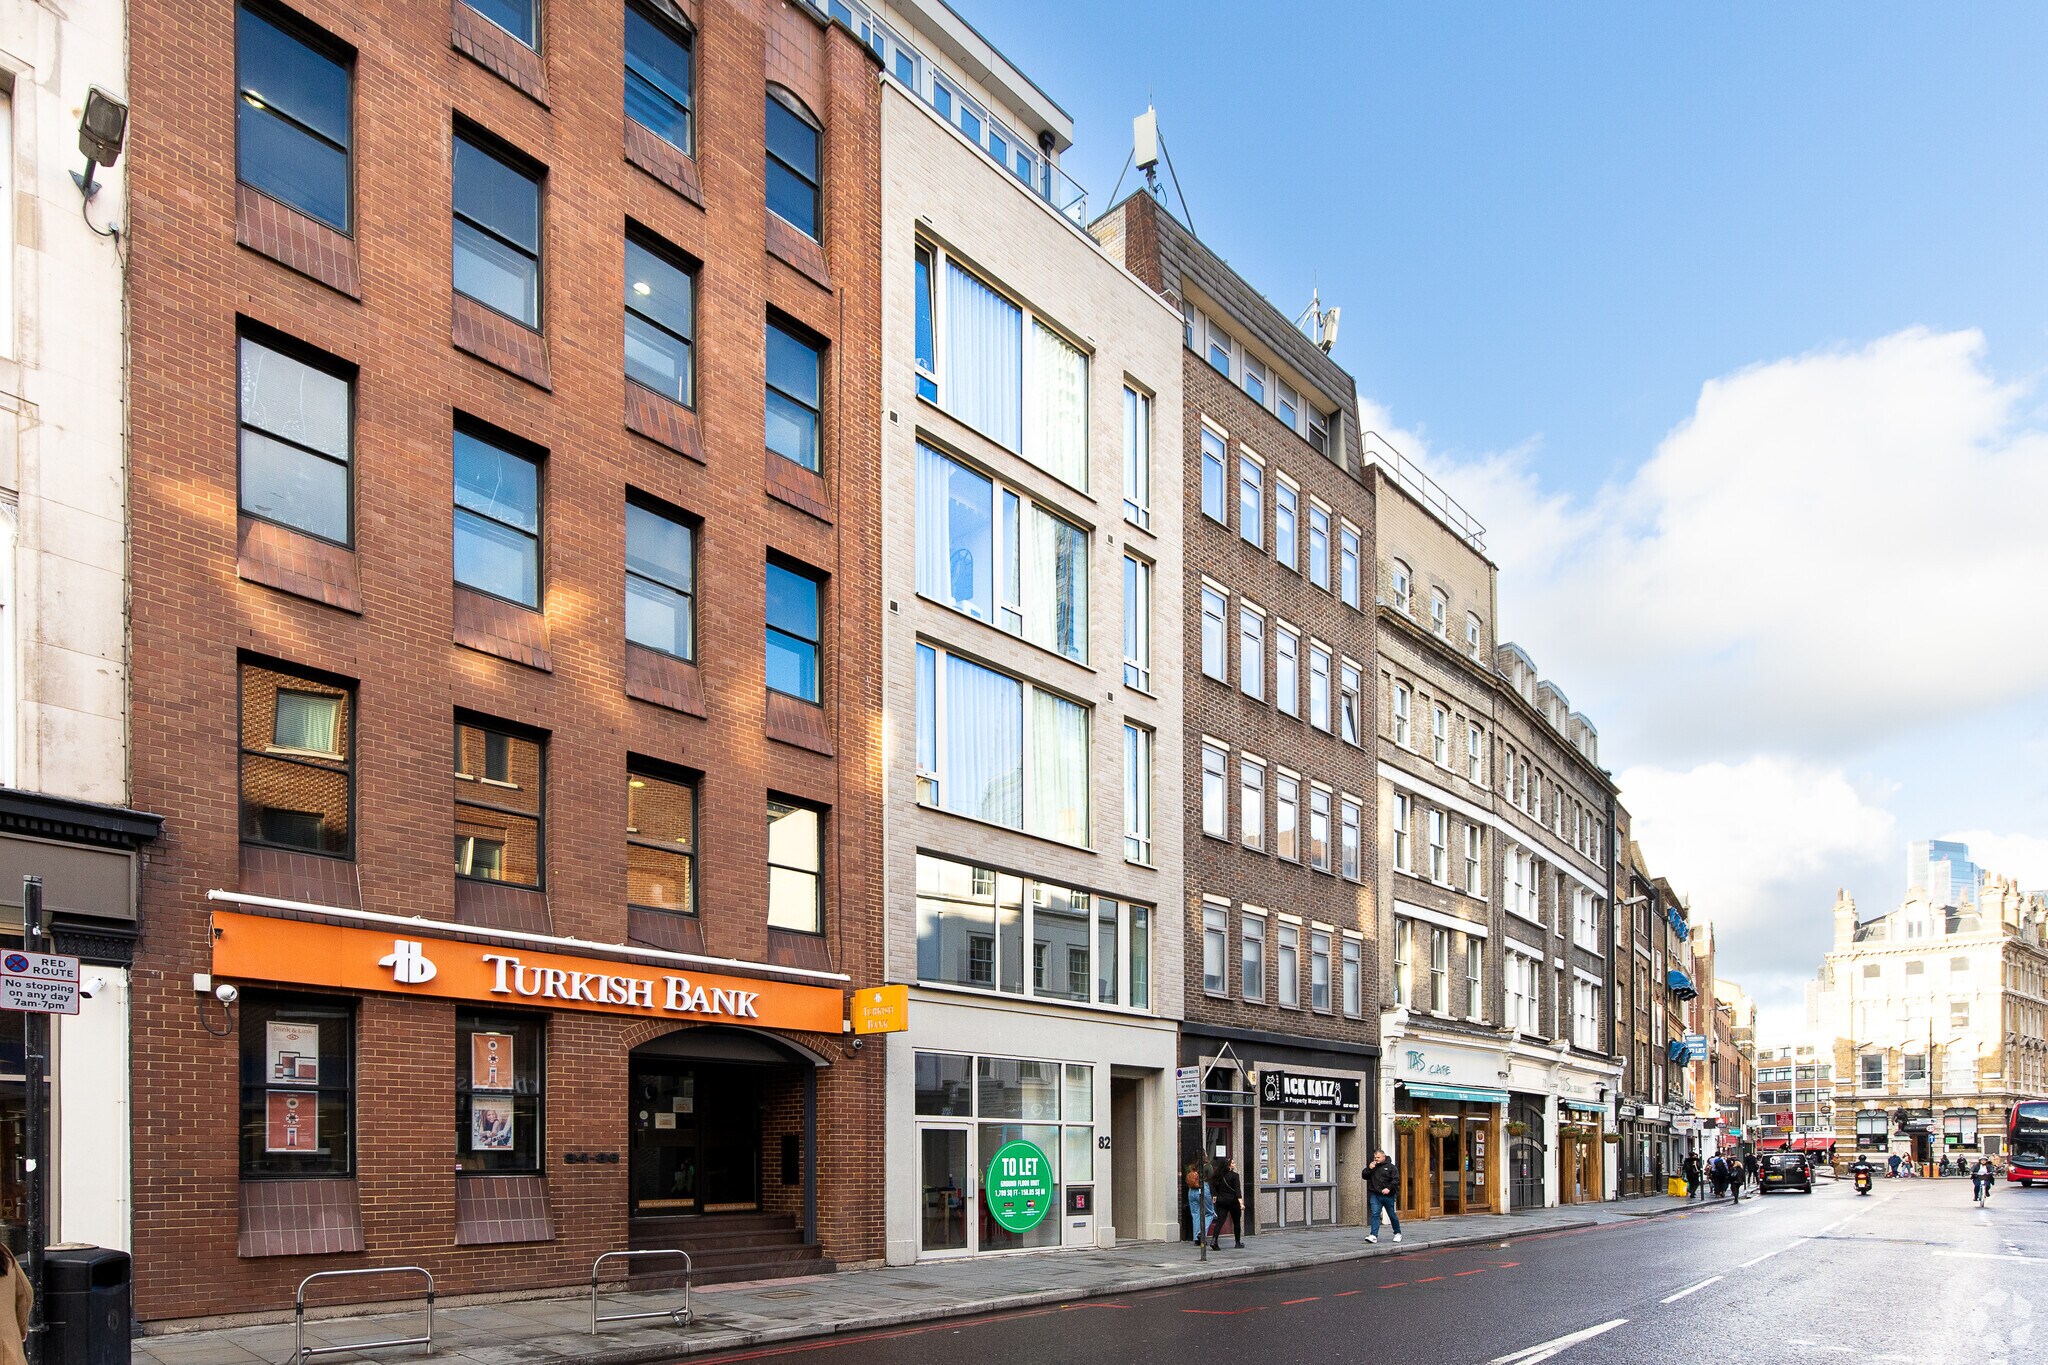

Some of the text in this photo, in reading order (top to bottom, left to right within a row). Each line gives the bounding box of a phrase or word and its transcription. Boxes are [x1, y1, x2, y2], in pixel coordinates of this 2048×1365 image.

[41, 958, 66, 967] RED
[33, 966, 74, 978] ROUTE
[5, 979, 74, 993] No stopping
[27, 992, 47, 1000] any
[50, 993, 70, 1002] day
[14, 998, 65, 1009] 7am-7pm
[1406, 1050, 1452, 1076] TAS CAFE
[1284, 1077, 1335, 1097] ACK KATZ
[1289, 1096, 1307, 1105] Property
[1308, 1098, 1333, 1106] Management
[1098, 1136, 1111, 1149] 82
[1001, 1157, 1038, 1176] TO LET
[1000, 1180, 1017, 1188] GROUND
[1017, 1179, 1030, 1187] FLOOR
[1007, 1189, 1013, 1197] SQ
[1035, 1188, 1041, 1196] SQ
